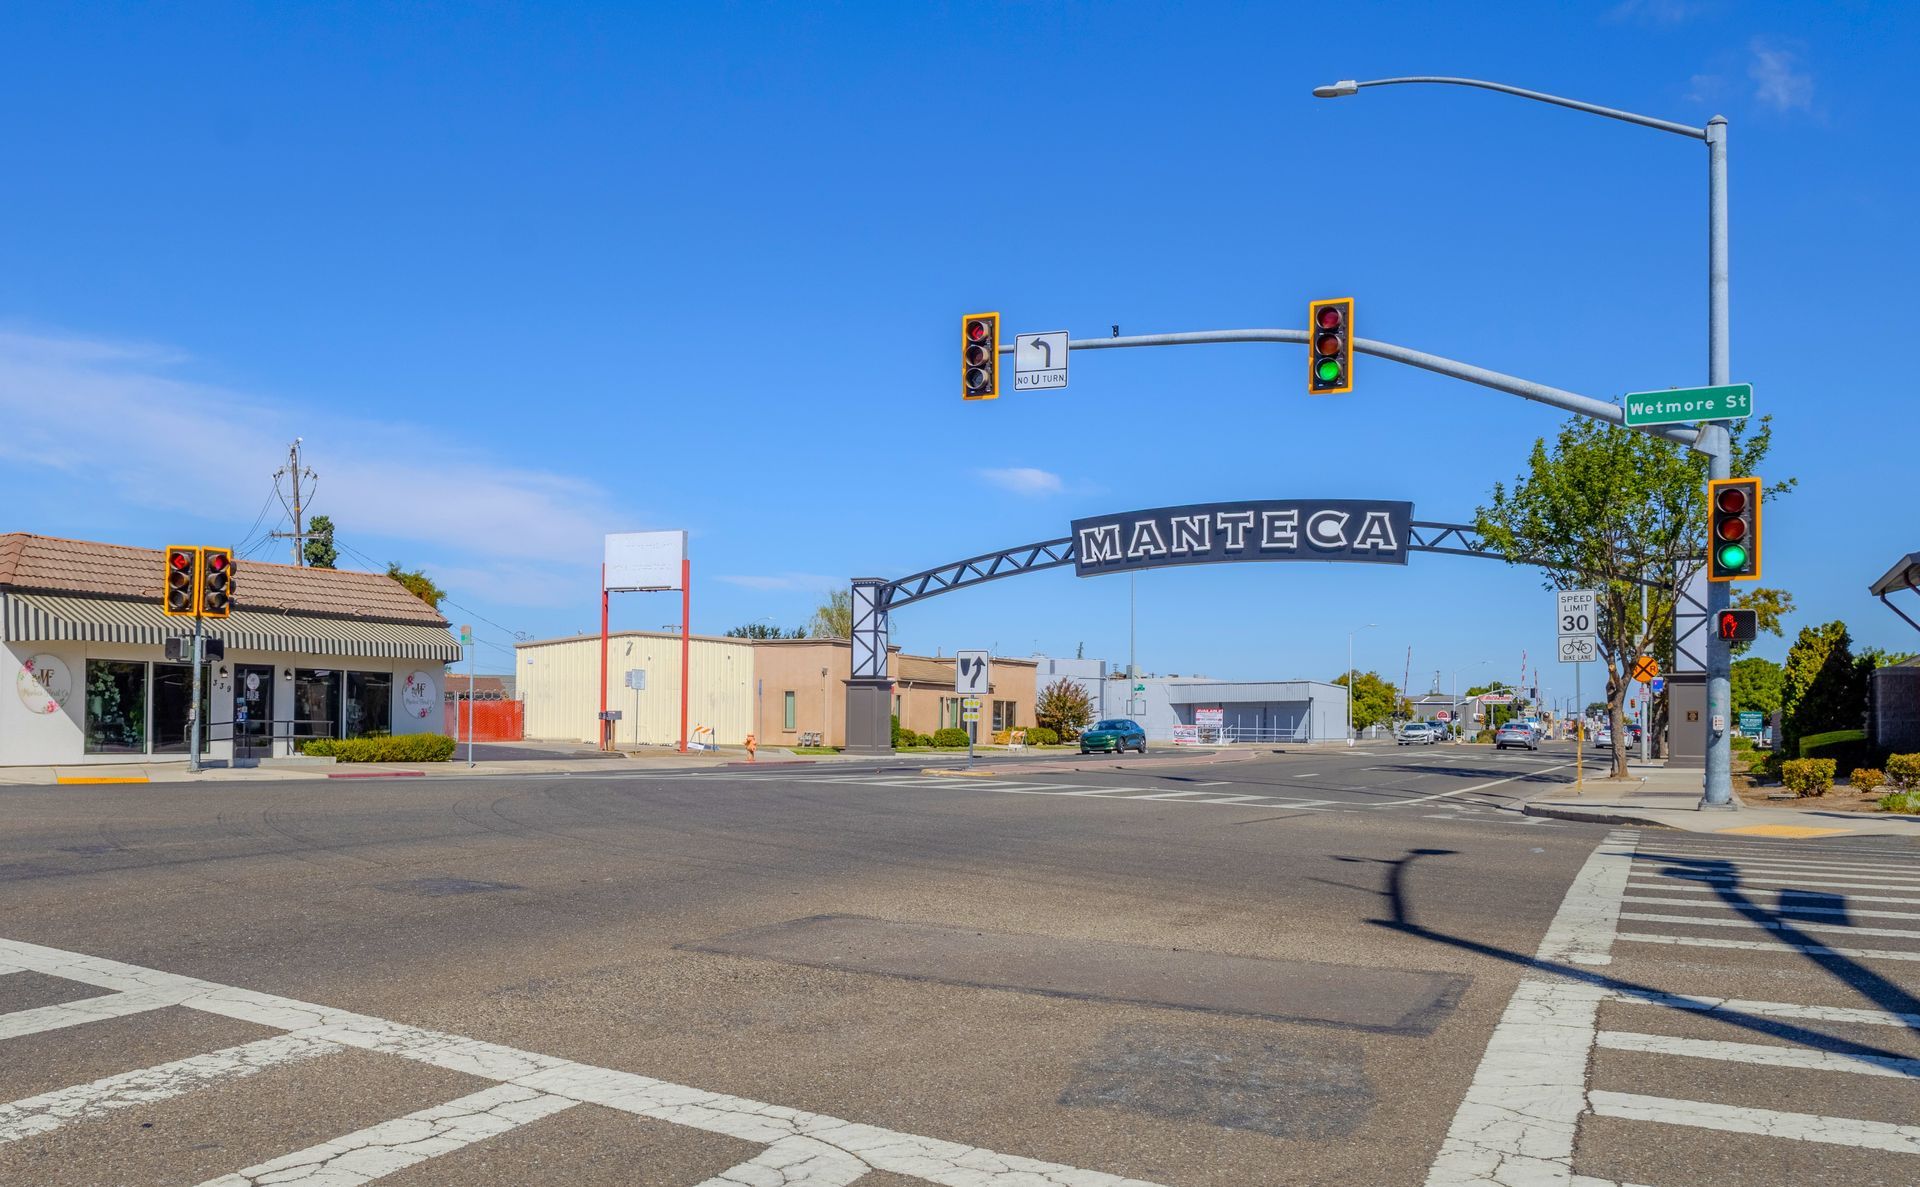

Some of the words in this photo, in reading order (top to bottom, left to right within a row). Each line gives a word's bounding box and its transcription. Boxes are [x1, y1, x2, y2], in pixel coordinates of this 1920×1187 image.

[1031, 374, 1040, 385] U
[1042, 374, 1065, 383] TURN
[1629, 399, 1715, 415] Wetmore
[1725, 394, 1746, 408] St
[1079, 508, 1398, 564] MANTECA
[1560, 595, 1592, 603] SPEED
[1563, 604, 1589, 612] LIMIT
[1562, 614, 1589, 631] 30
[213, 679, 232, 692] 339
